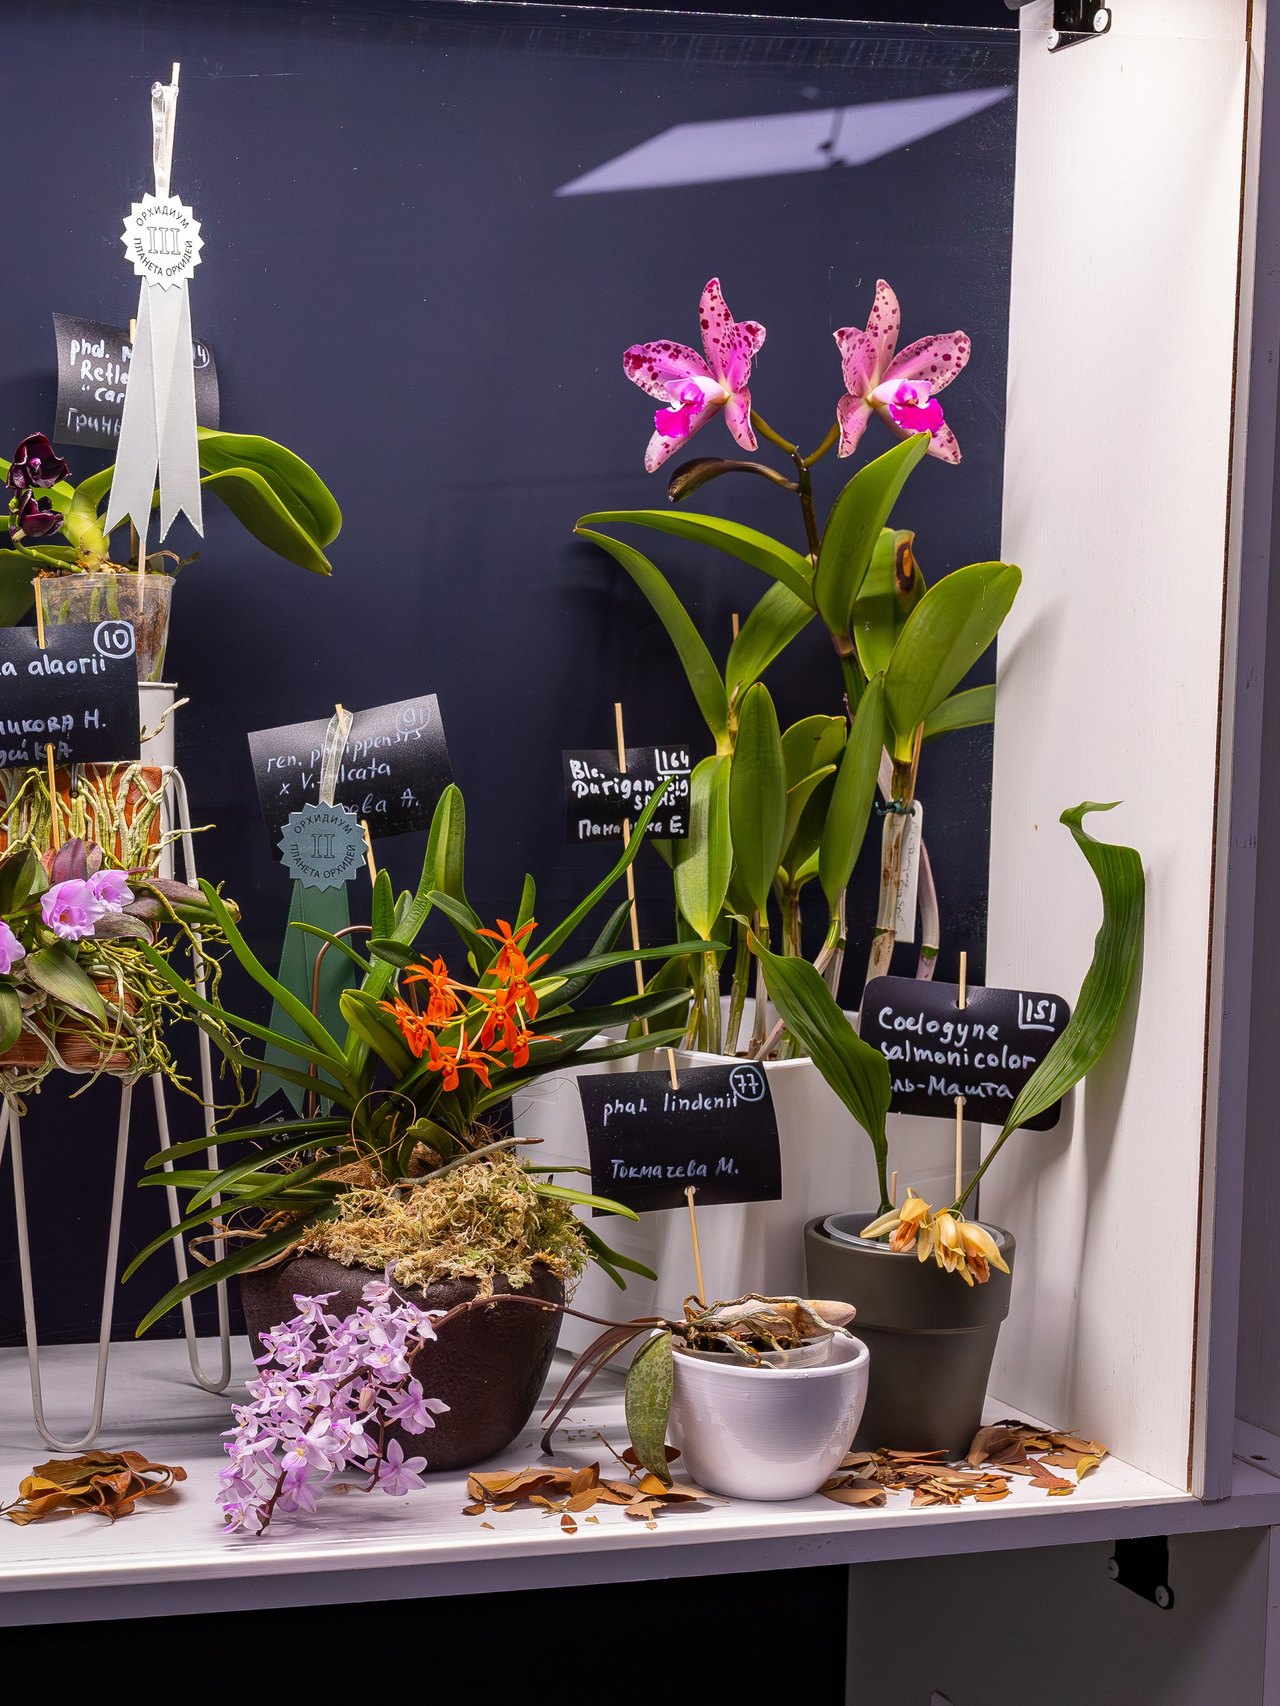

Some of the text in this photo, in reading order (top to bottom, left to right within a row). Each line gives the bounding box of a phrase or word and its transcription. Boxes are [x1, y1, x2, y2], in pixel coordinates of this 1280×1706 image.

[136, 205, 189, 228] ОРХИДИУМ
[146, 226, 181, 256] III
[133, 237, 193, 277] ПЛАНЕТА ОРХИДЕЙ
[81, 359, 128, 386] Refle
[104, 629, 129, 649] 10
[27, 653, 106, 677] alaorii
[661, 750, 689, 771] 164
[293, 814, 353, 834] ОРХИДИУМ
[311, 833, 336, 858] II
[290, 843, 356, 879] ПЛАНЕТА ОРХИДЕЙ
[878, 1006, 999, 1048] Coelogyne
[734, 1074, 759, 1095] 77
[889, 1074, 1015, 1100] ль-Машта
[663, 1090, 738, 1113] lindenii
